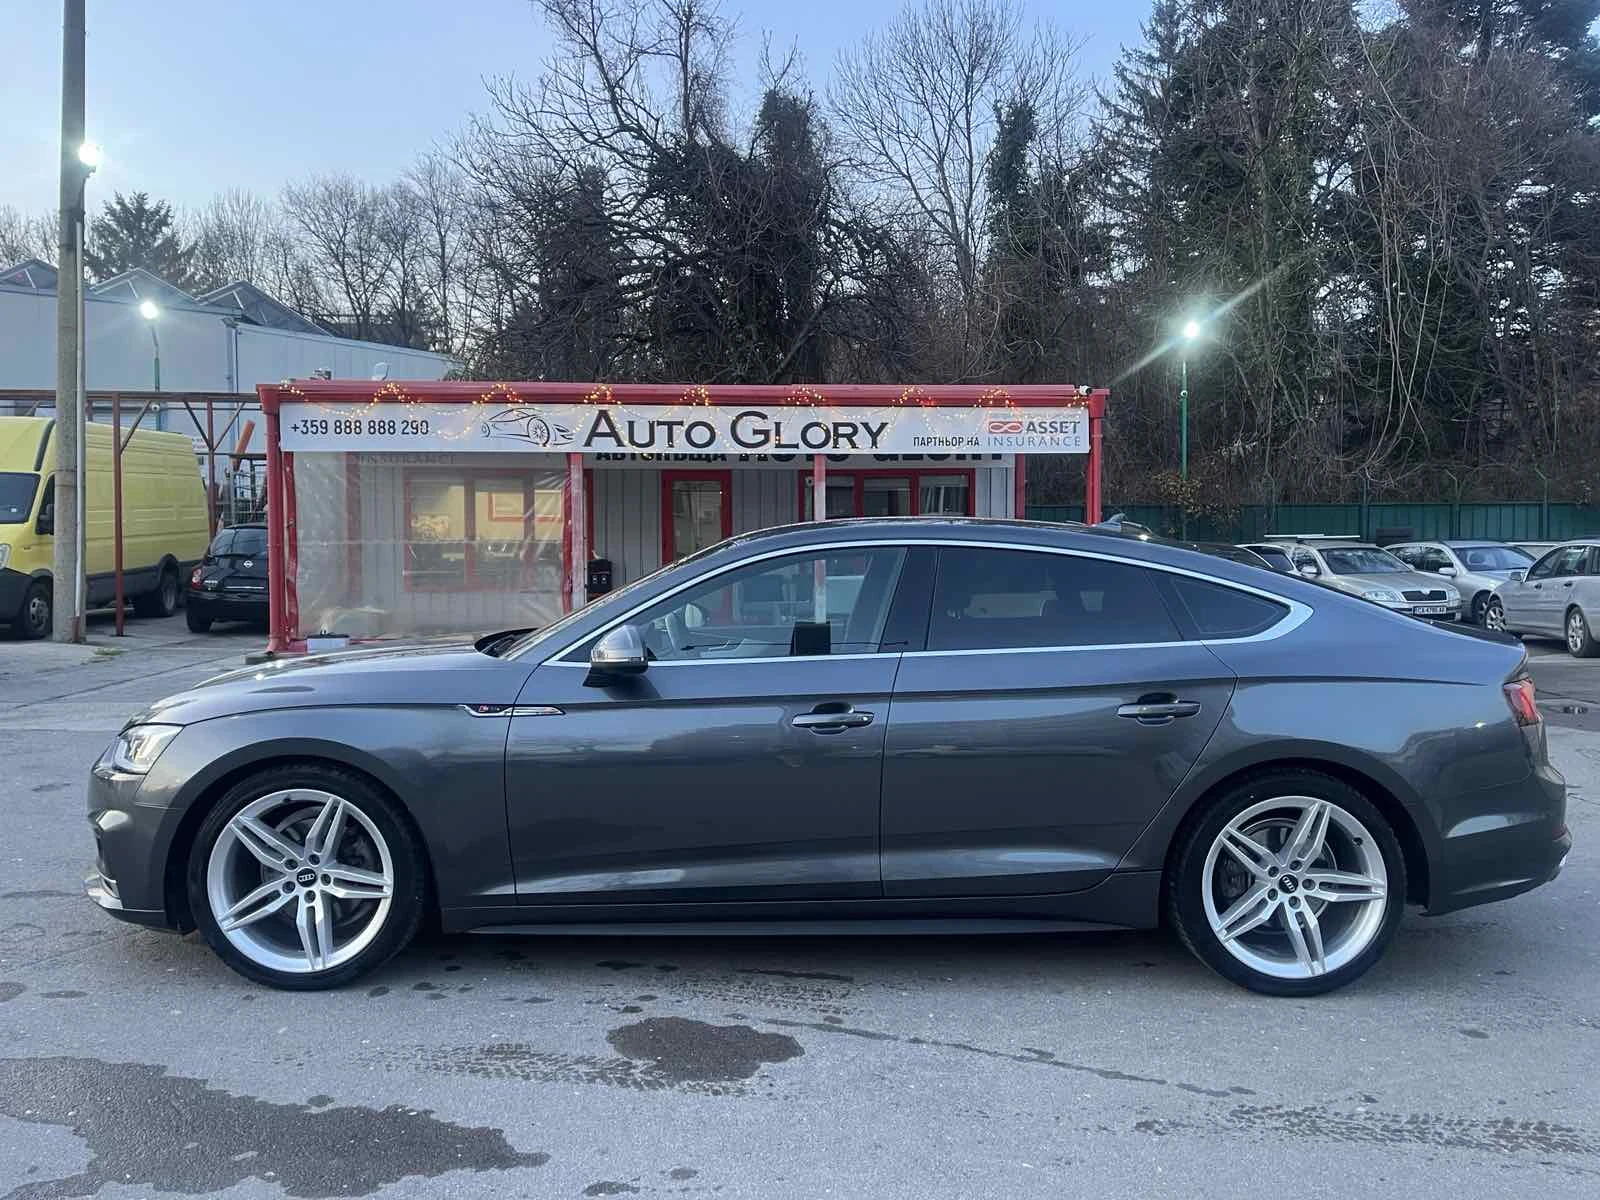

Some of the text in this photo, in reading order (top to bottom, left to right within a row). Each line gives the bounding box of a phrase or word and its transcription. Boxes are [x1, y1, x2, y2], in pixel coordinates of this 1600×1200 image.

[291, 419, 429, 435] +359 888 888 290
[583, 409, 889, 449] AUTO GLORY
[1026, 421, 1081, 434] ASSET
[913, 436, 980, 447] ПАРТНЬОР НА
[987, 436, 1081, 447] INSURANCE
